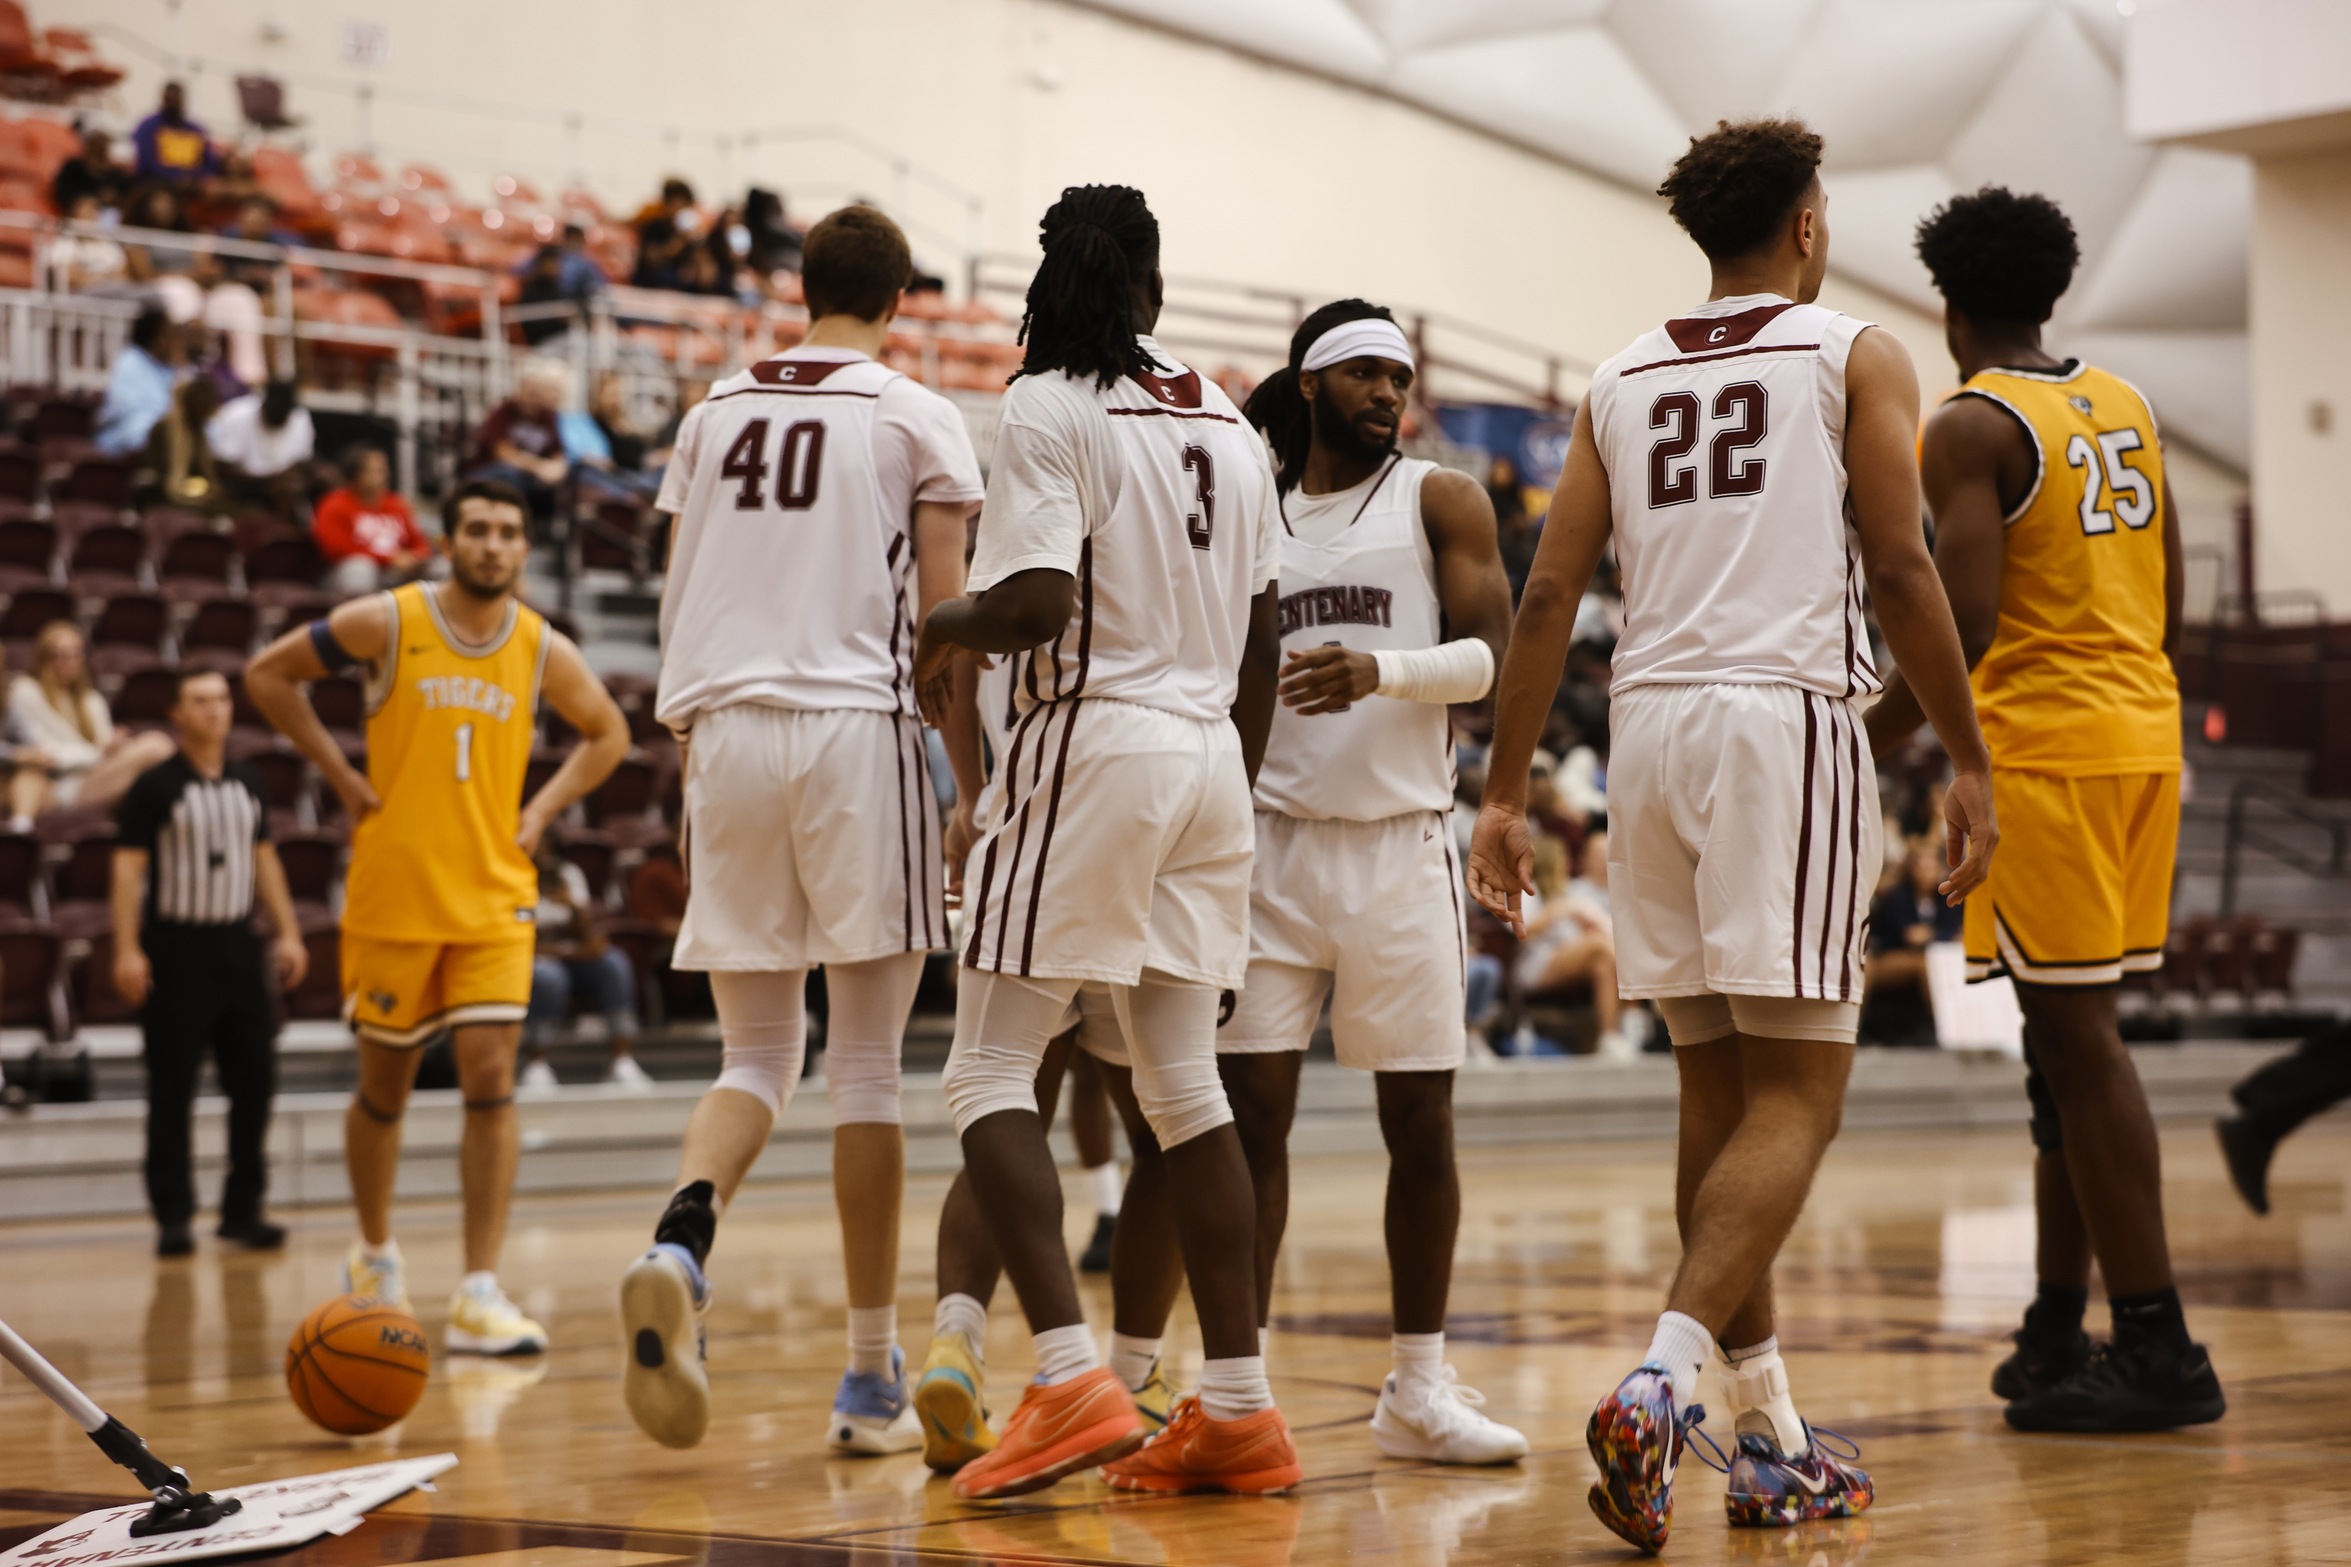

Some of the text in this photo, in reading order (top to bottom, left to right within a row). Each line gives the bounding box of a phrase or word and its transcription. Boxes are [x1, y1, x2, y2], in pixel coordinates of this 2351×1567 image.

[720, 417, 828, 512] 40
[1648, 380, 1768, 510] 22
[2066, 426, 2156, 538] 25
[1182, 443, 1215, 551] 3
[1278, 585, 1393, 640] ENTENARY
[417, 675, 516, 723] TIGERS
[455, 722, 473, 782] 1
